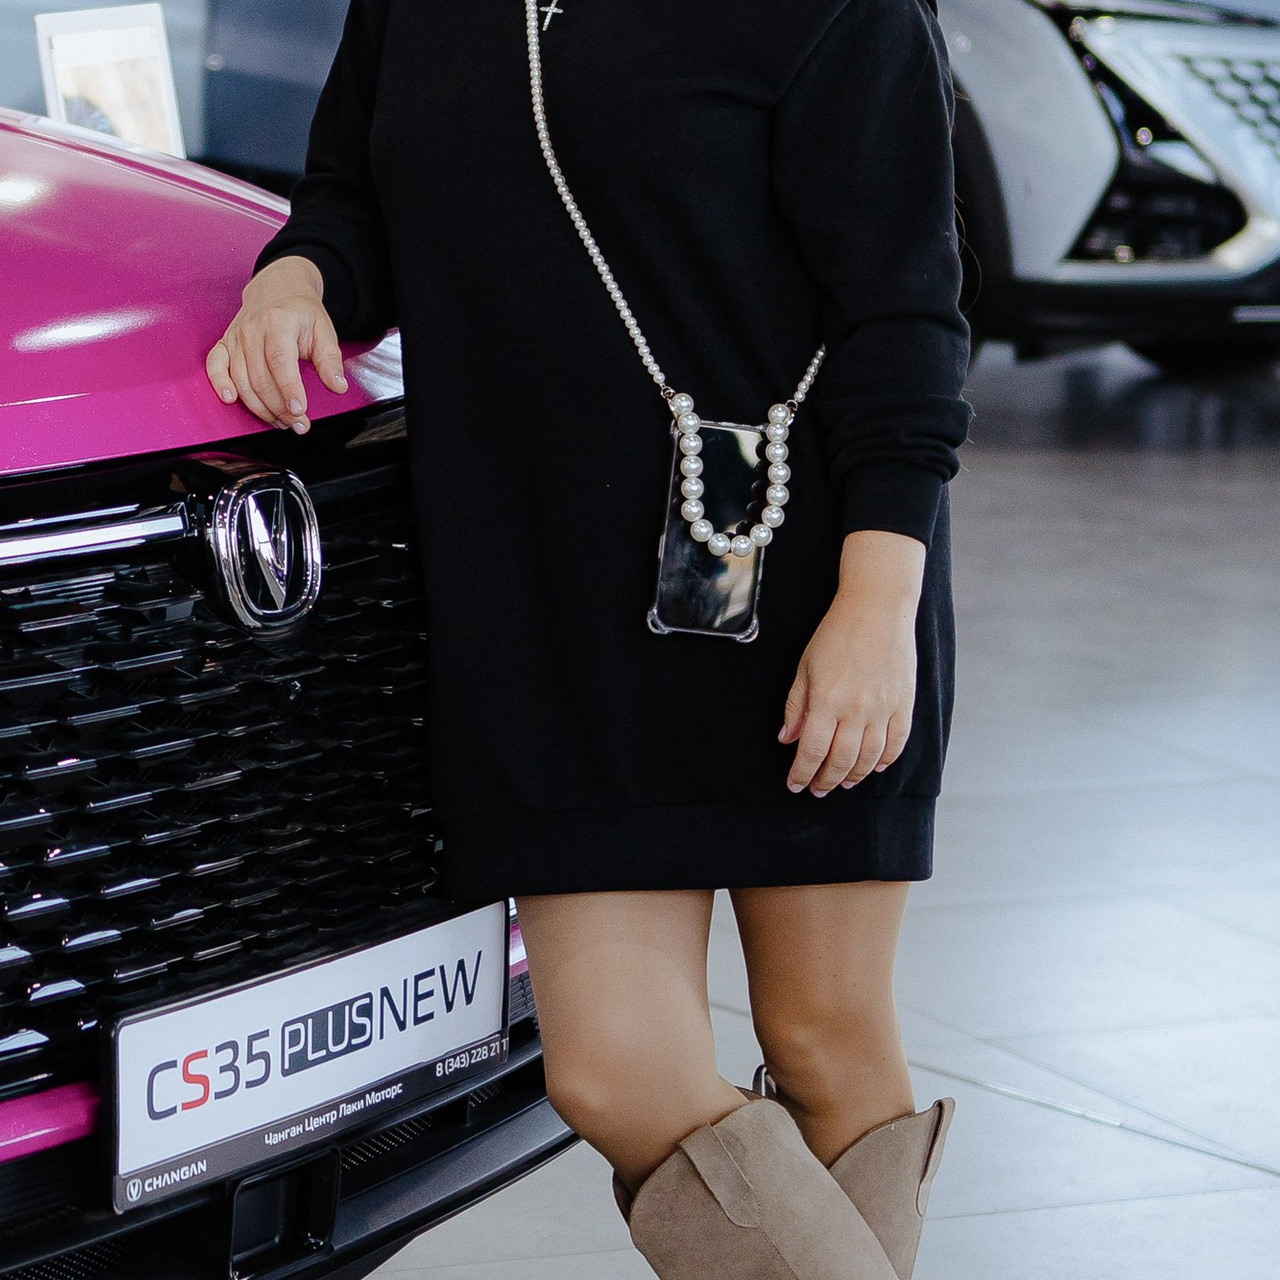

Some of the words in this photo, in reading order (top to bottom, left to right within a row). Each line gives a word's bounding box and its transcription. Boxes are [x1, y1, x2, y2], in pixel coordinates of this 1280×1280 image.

[146, 1028, 271, 1121] CS35
[283, 996, 372, 1071] PLUS
[379, 949, 484, 1042] NEW
[435, 1062, 443, 1077] 8
[444, 1051, 469, 1075] (343)
[470, 1045, 488, 1064] 228
[490, 1040, 500, 1057] 21
[264, 1123, 303, 1146] Чанган
[304, 1110, 337, 1132] Центр
[338, 1099, 365, 1118] Лаки
[365, 1082, 403, 1107] Моторс
[144, 1159, 207, 1192] CHANGAN
